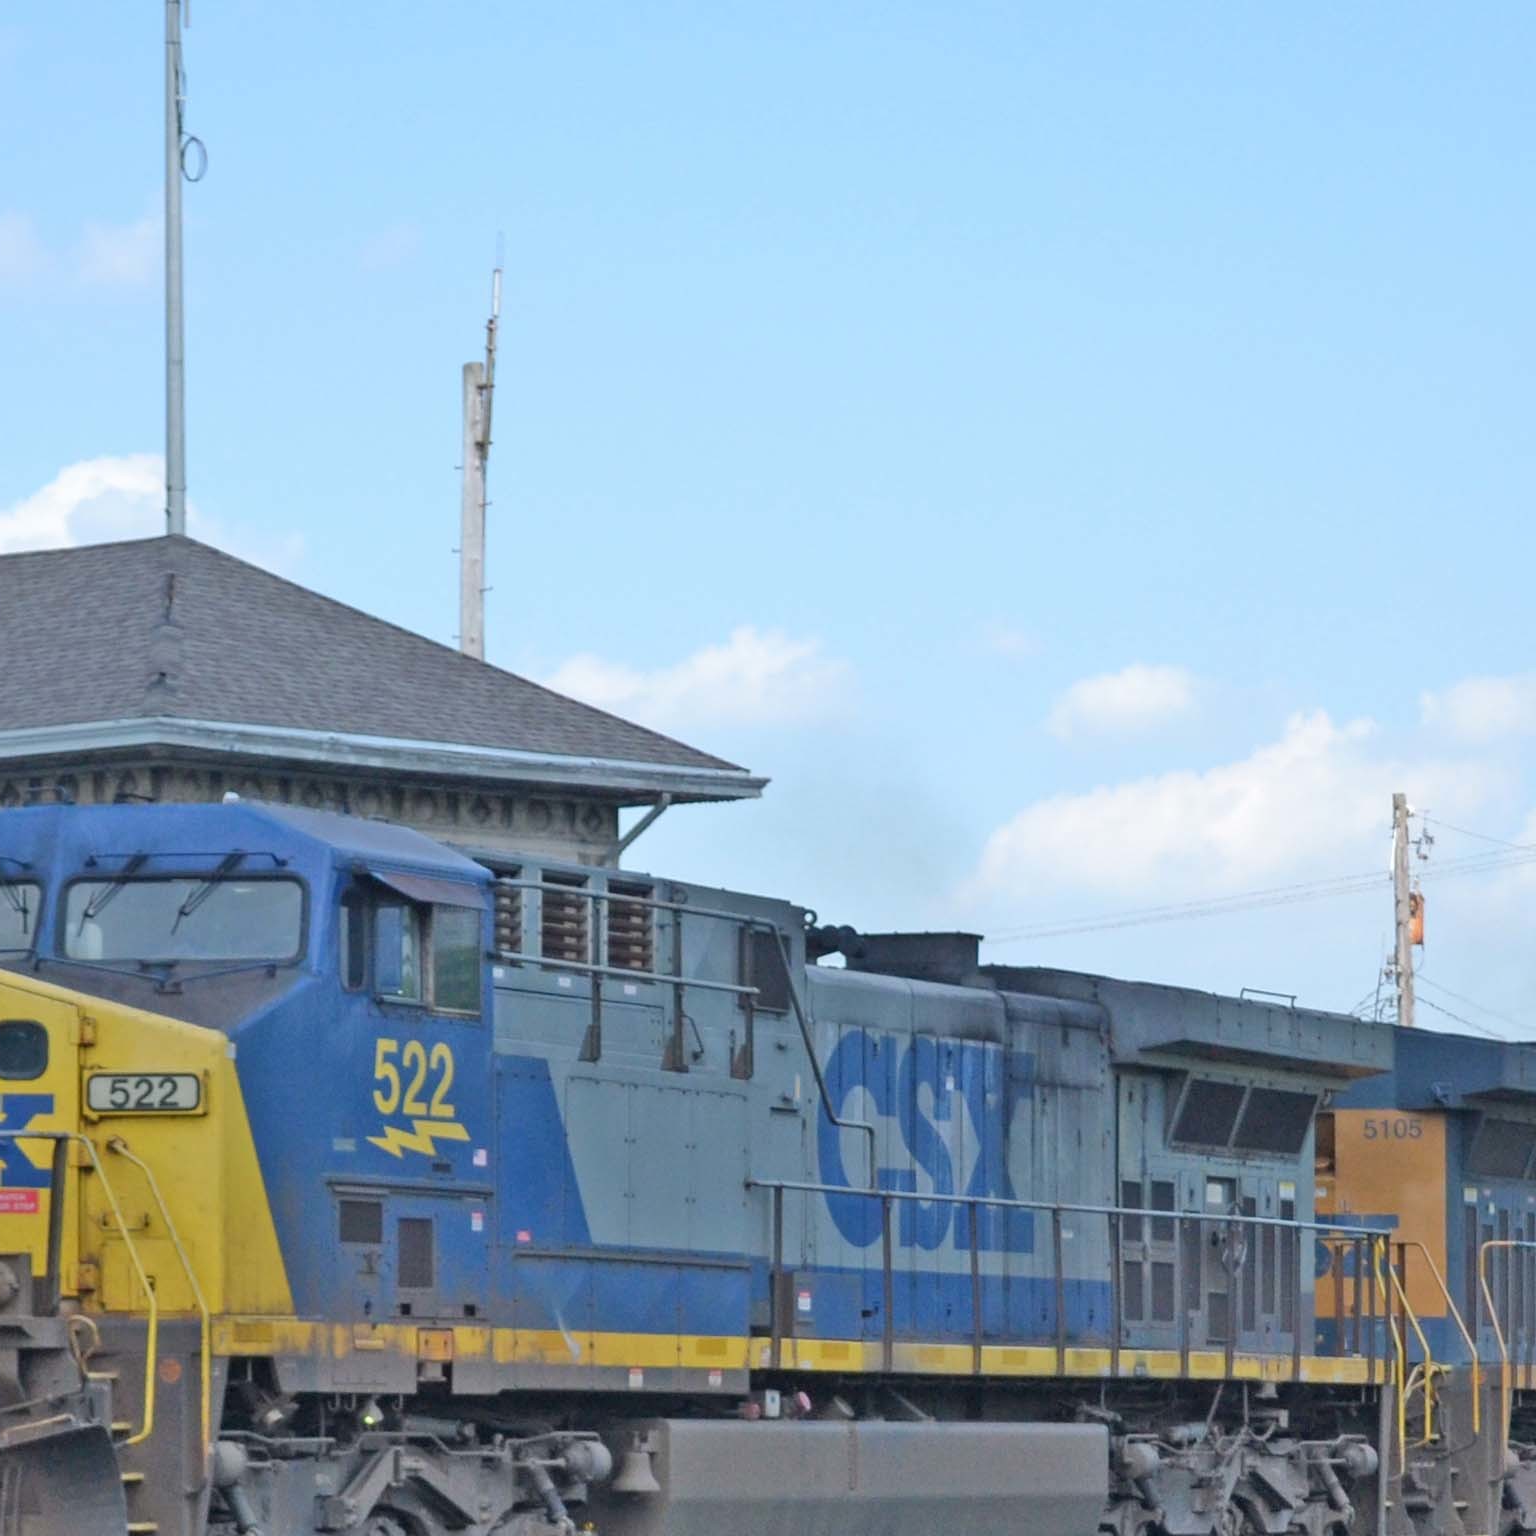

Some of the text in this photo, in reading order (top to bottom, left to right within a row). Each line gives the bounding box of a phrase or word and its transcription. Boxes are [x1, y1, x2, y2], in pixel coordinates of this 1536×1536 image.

[109, 1078, 179, 1109] 522
[372, 1038, 455, 1118] 522
[817, 1030, 1035, 1254] CSX
[1364, 1119, 1423, 1139] 5105
